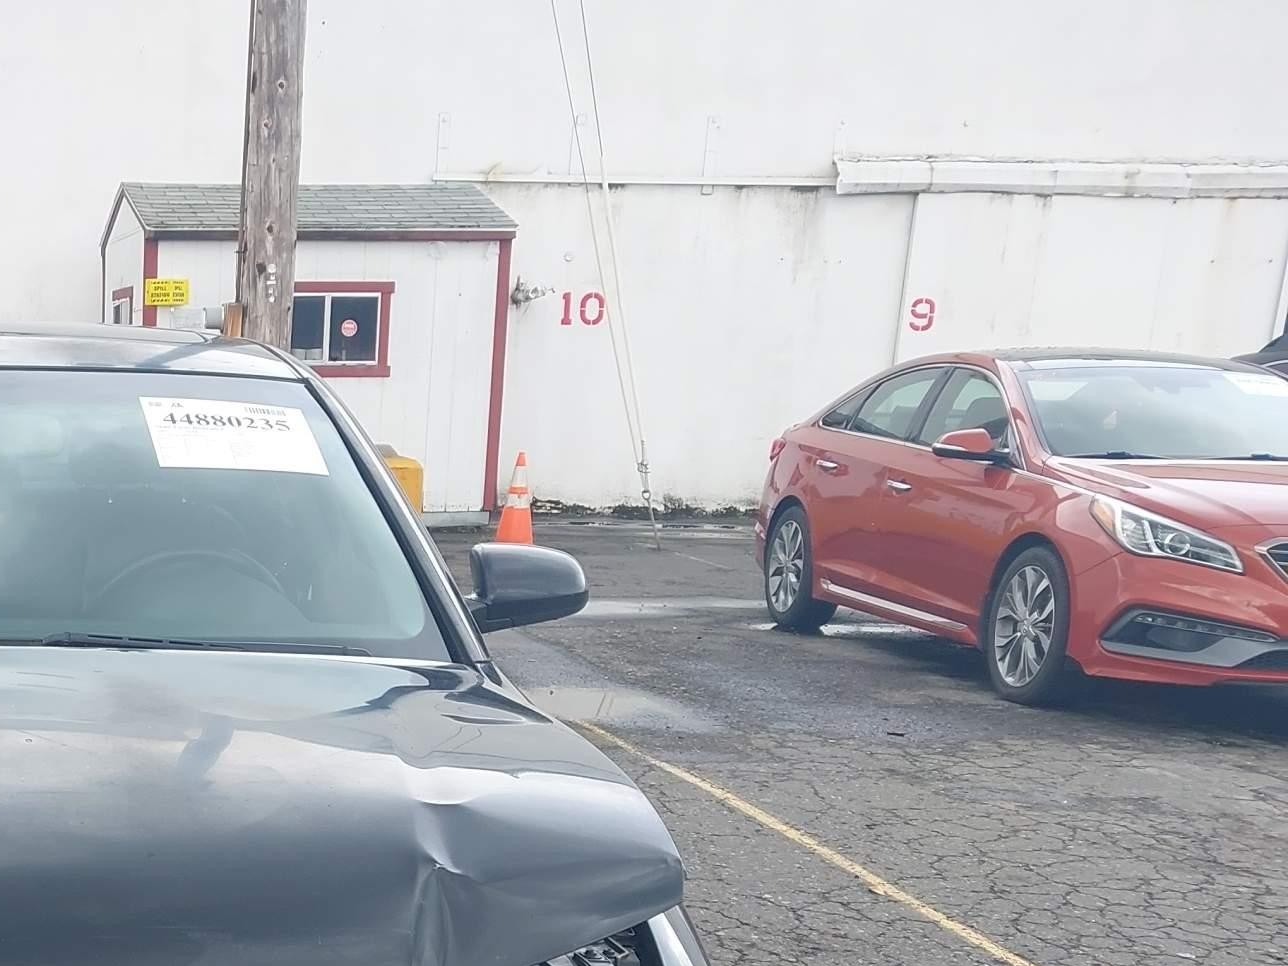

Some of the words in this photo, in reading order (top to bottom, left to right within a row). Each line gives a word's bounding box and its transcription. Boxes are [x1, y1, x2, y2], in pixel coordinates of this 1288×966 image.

[560, 291, 605, 326] 10
[909, 297, 936, 332] 9
[163, 412, 291, 431] 44880235
